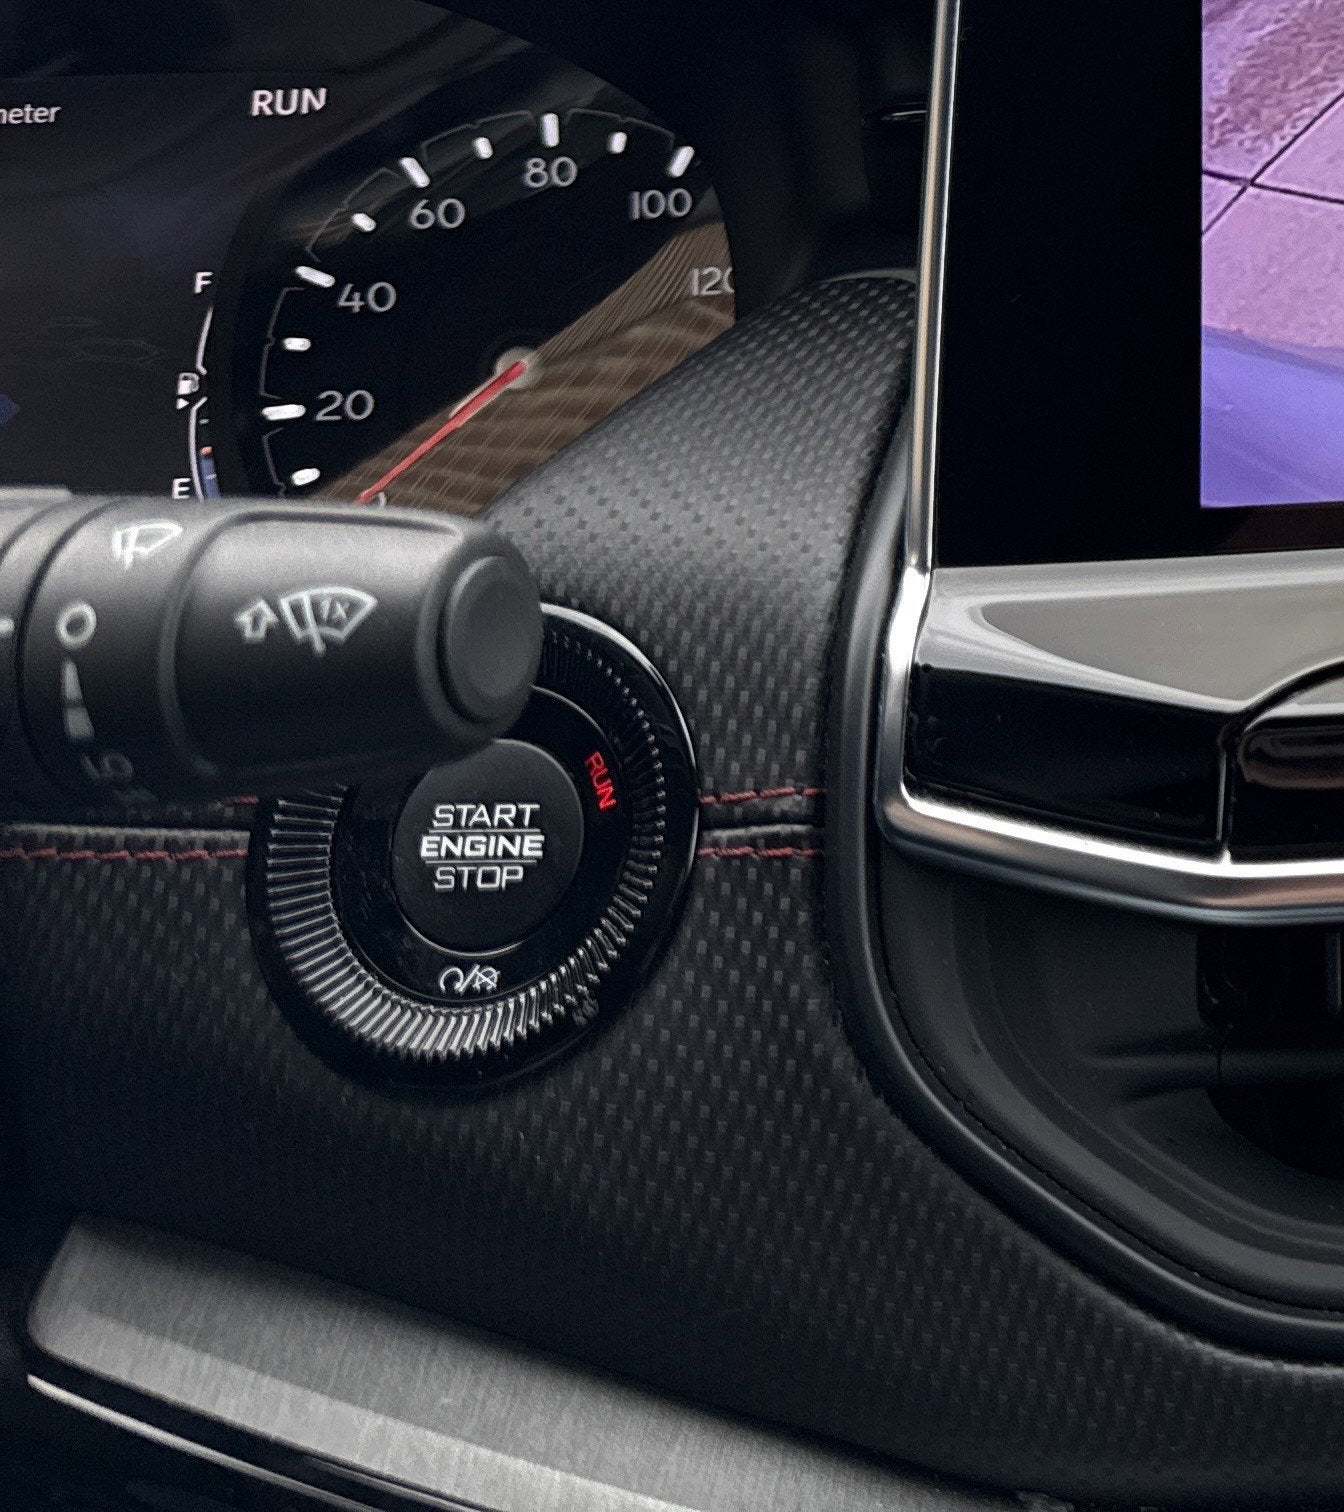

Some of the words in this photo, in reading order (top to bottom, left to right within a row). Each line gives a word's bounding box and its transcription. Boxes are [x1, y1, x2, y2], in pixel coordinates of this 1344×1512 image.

[251, 87, 327, 117] RUN
[523, 156, 579, 188] 80
[409, 198, 466, 230] 60
[628, 188, 693, 221] 100
[194, 271, 214, 294] F
[337, 281, 397, 313] 40
[314, 389, 375, 421] 20
[172, 477, 191, 500] E
[584, 750, 618, 811] RUN
[432, 803, 541, 828] START
[420, 834, 545, 859] ENGINE
[433, 865, 525, 892] STOP
